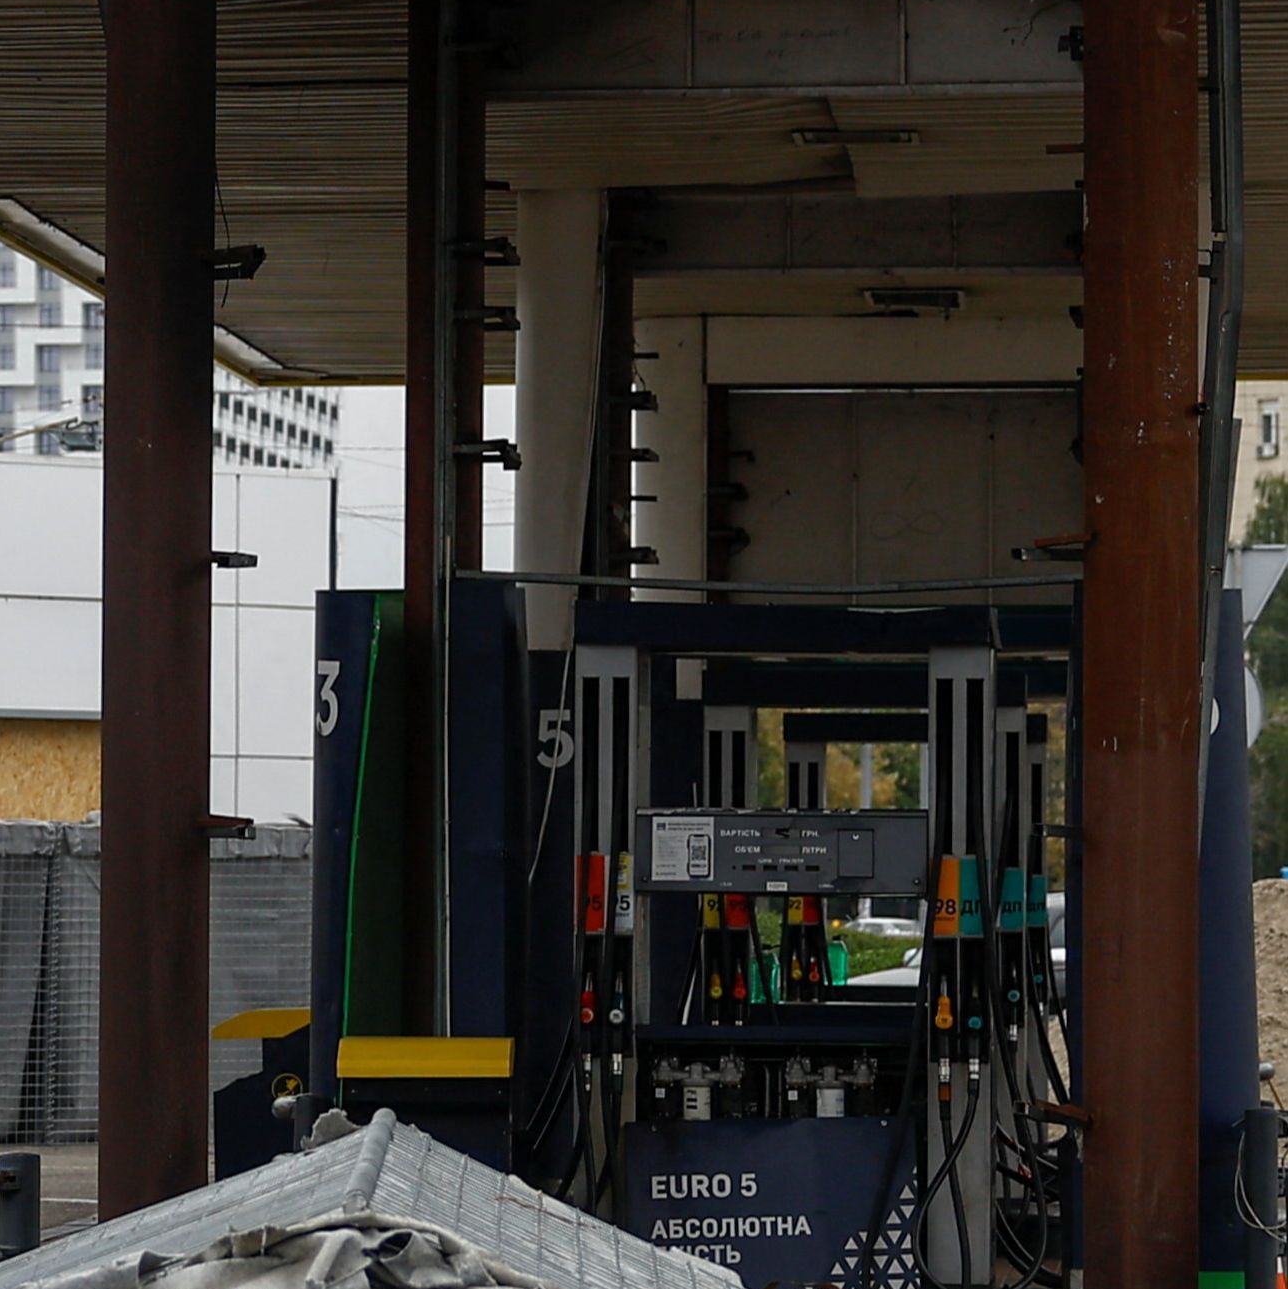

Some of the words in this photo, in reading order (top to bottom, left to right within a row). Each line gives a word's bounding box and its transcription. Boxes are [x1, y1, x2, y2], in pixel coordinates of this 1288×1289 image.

[316, 660, 340, 737] 3
[536, 709, 574, 768] 5
[720, 829, 761, 838] ВАРТІСТЬ
[615, 895, 630, 911] 5
[707, 899, 720, 912] 9
[651, 1173, 732, 1199] EURO
[740, 1173, 758, 1198] 5
[651, 1215, 812, 1240] АБСОЛЮТНА
